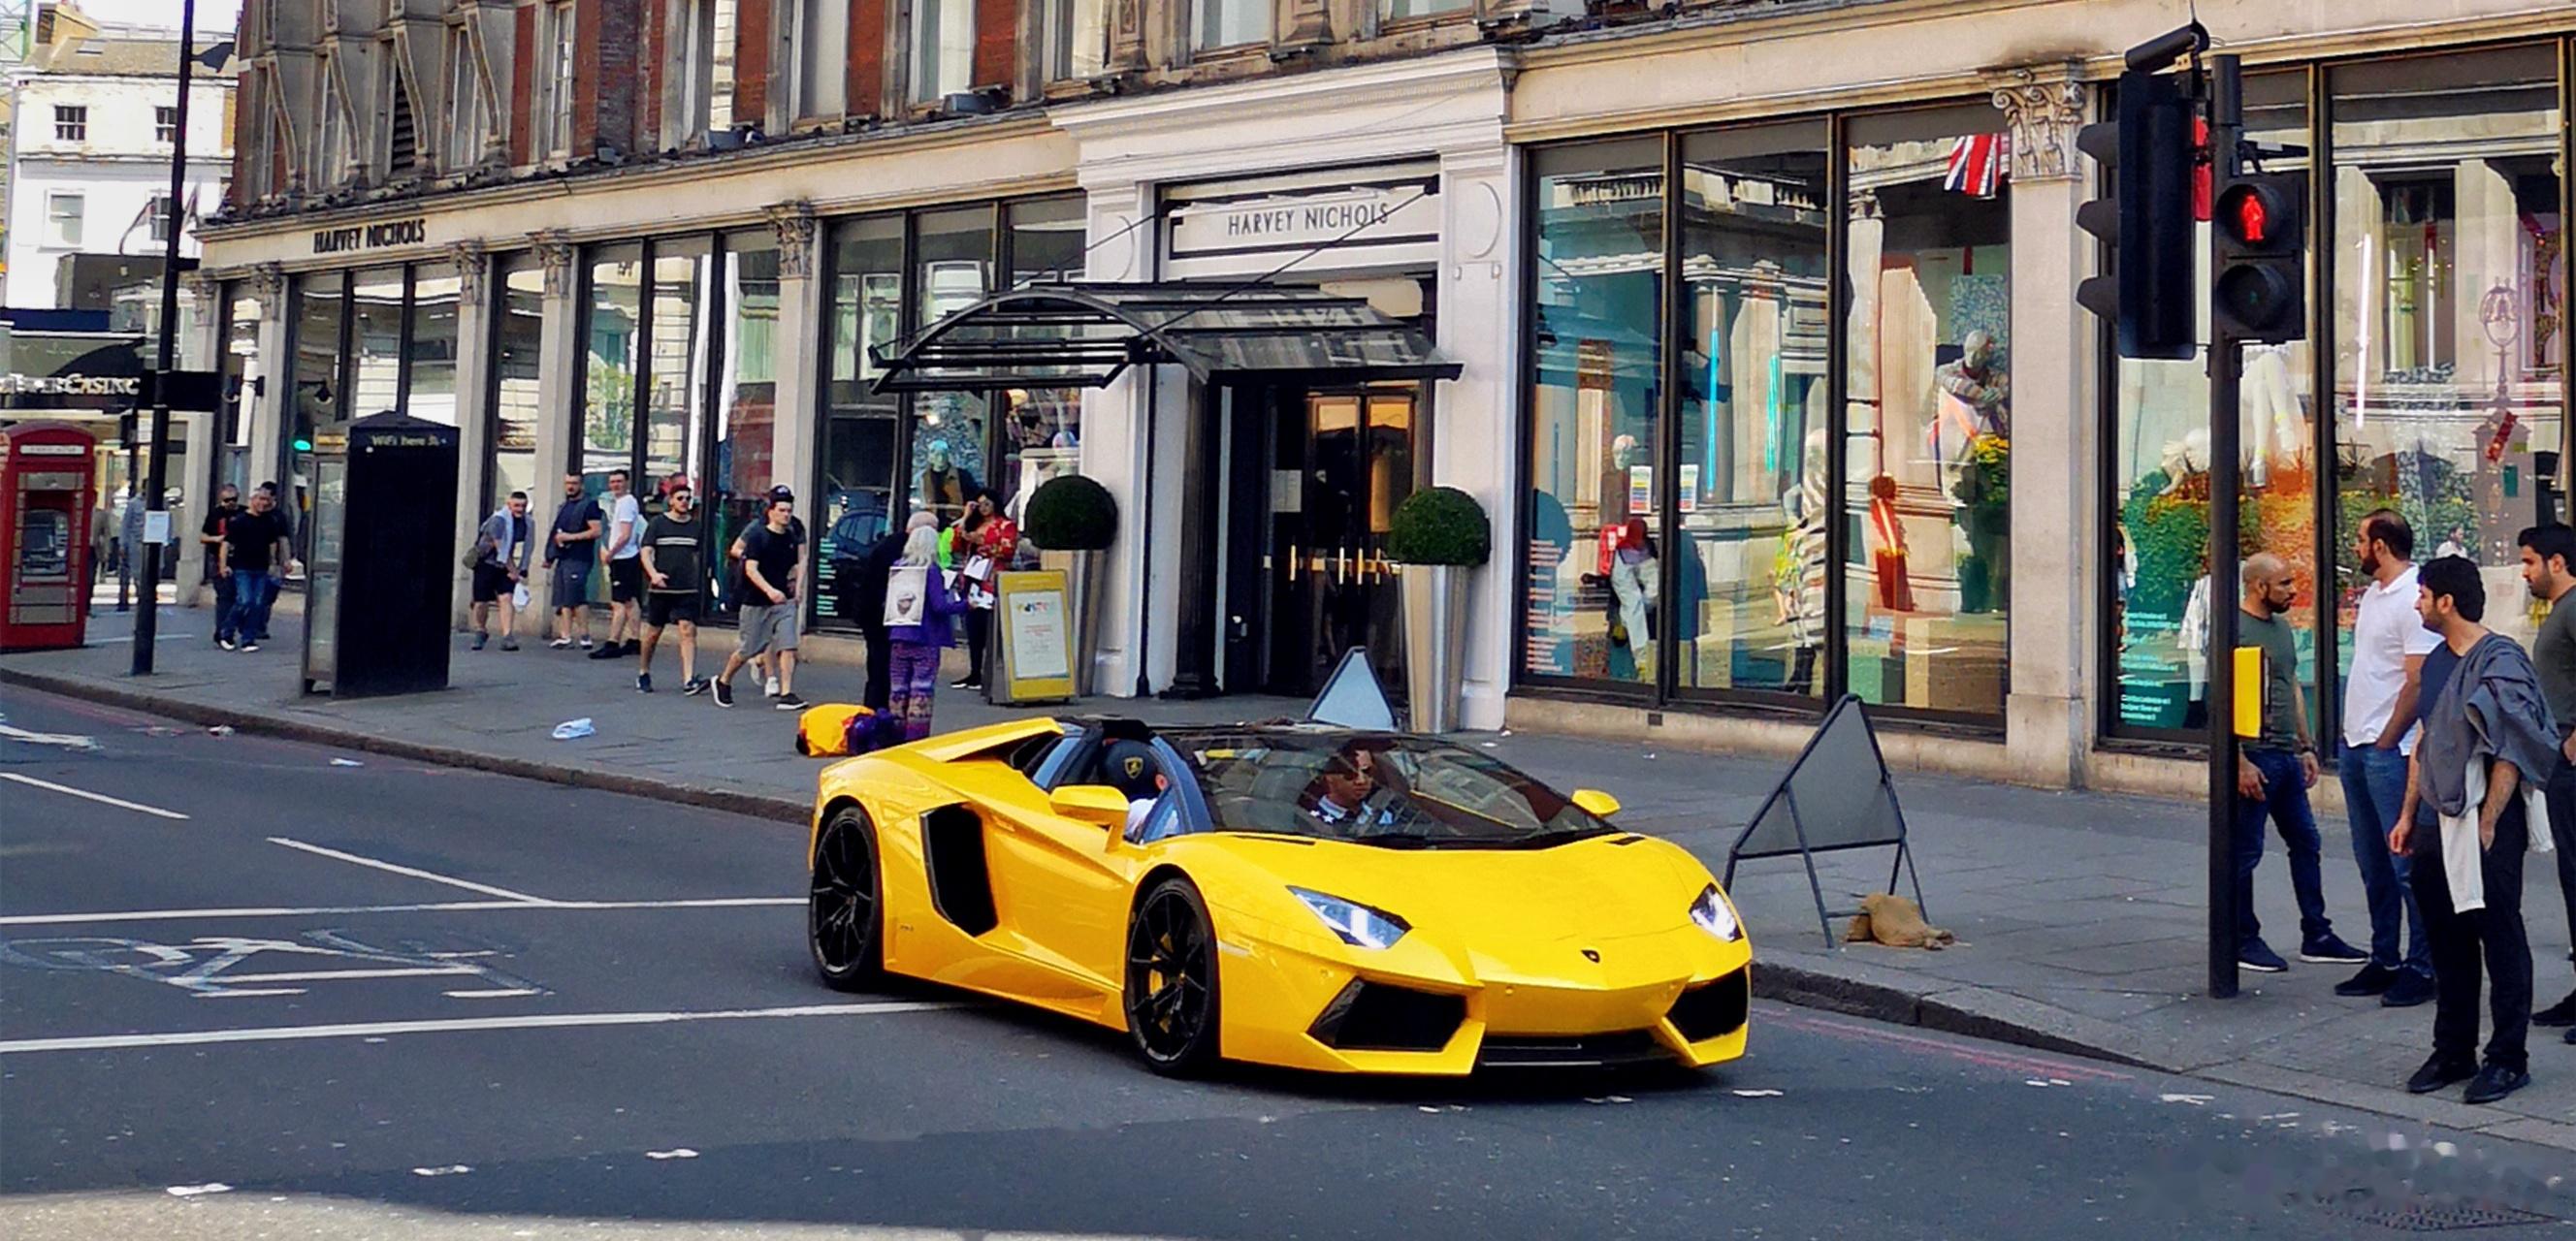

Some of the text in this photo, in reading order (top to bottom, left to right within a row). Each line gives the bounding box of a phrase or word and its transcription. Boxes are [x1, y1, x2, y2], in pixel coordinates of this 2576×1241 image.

[313, 217, 426, 253] HARVEY NICHOLS
[1228, 202, 1389, 236] HARVEY NICHOLS
